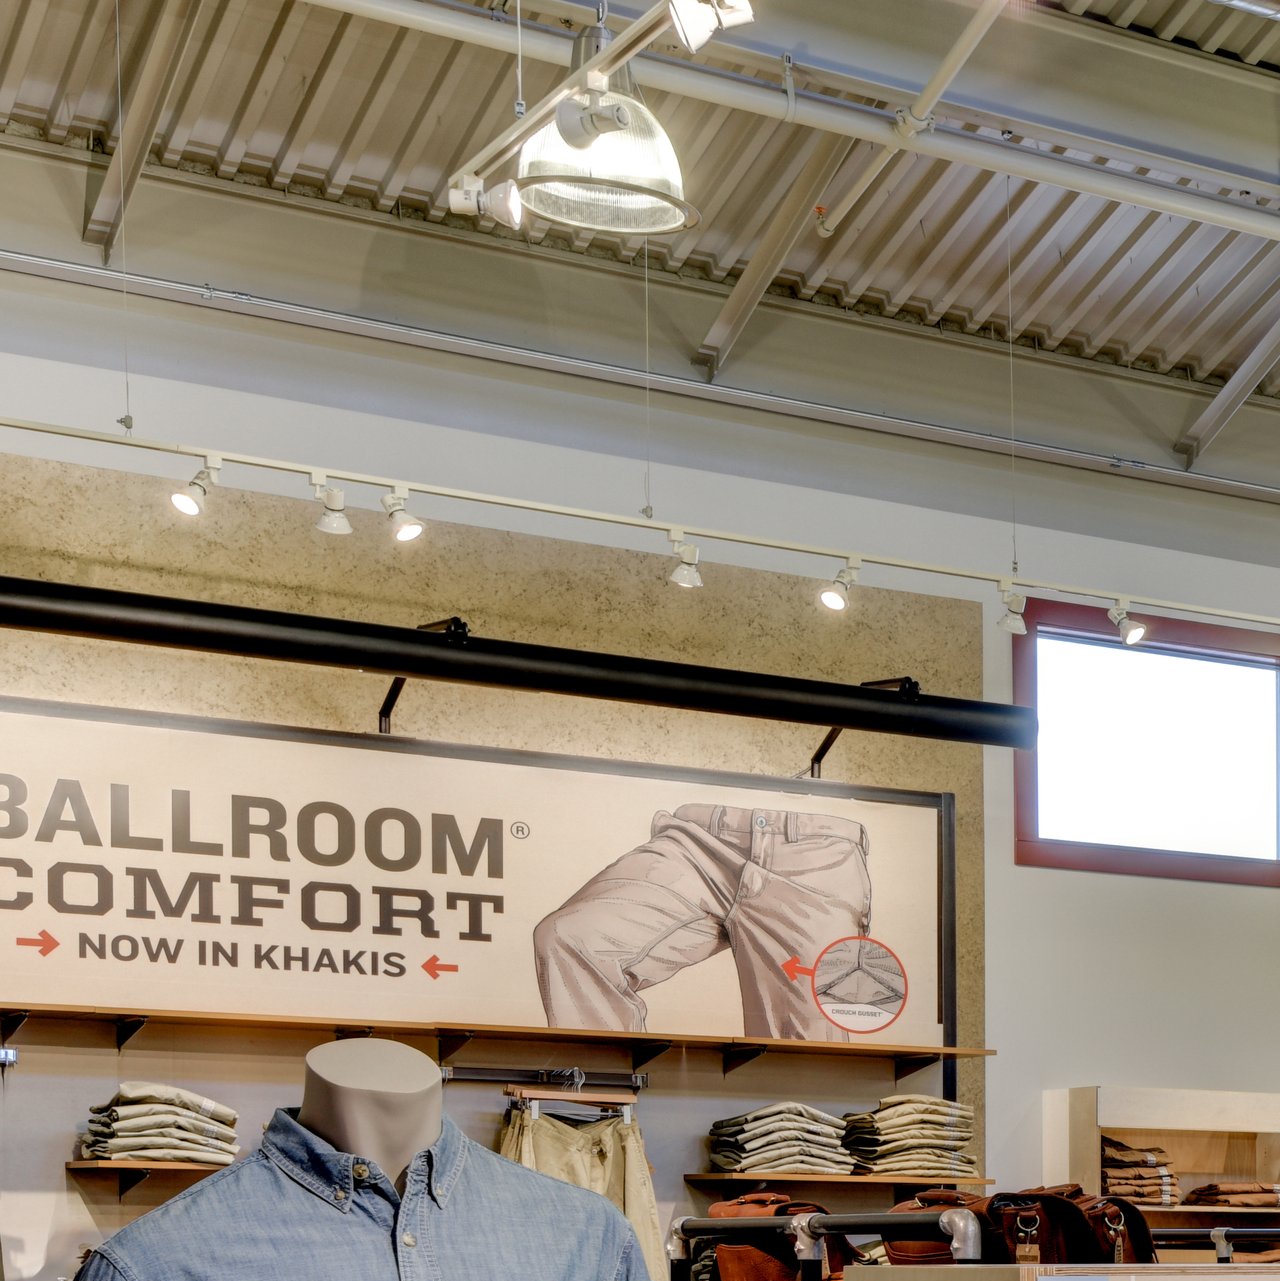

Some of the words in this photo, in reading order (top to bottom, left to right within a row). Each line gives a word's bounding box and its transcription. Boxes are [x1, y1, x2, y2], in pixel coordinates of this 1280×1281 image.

[78, 932, 184, 964] NOW
[198, 940, 240, 968] IN
[254, 944, 408, 978] KHAKIS
[831, 1008, 857, 1016] CROUCH
